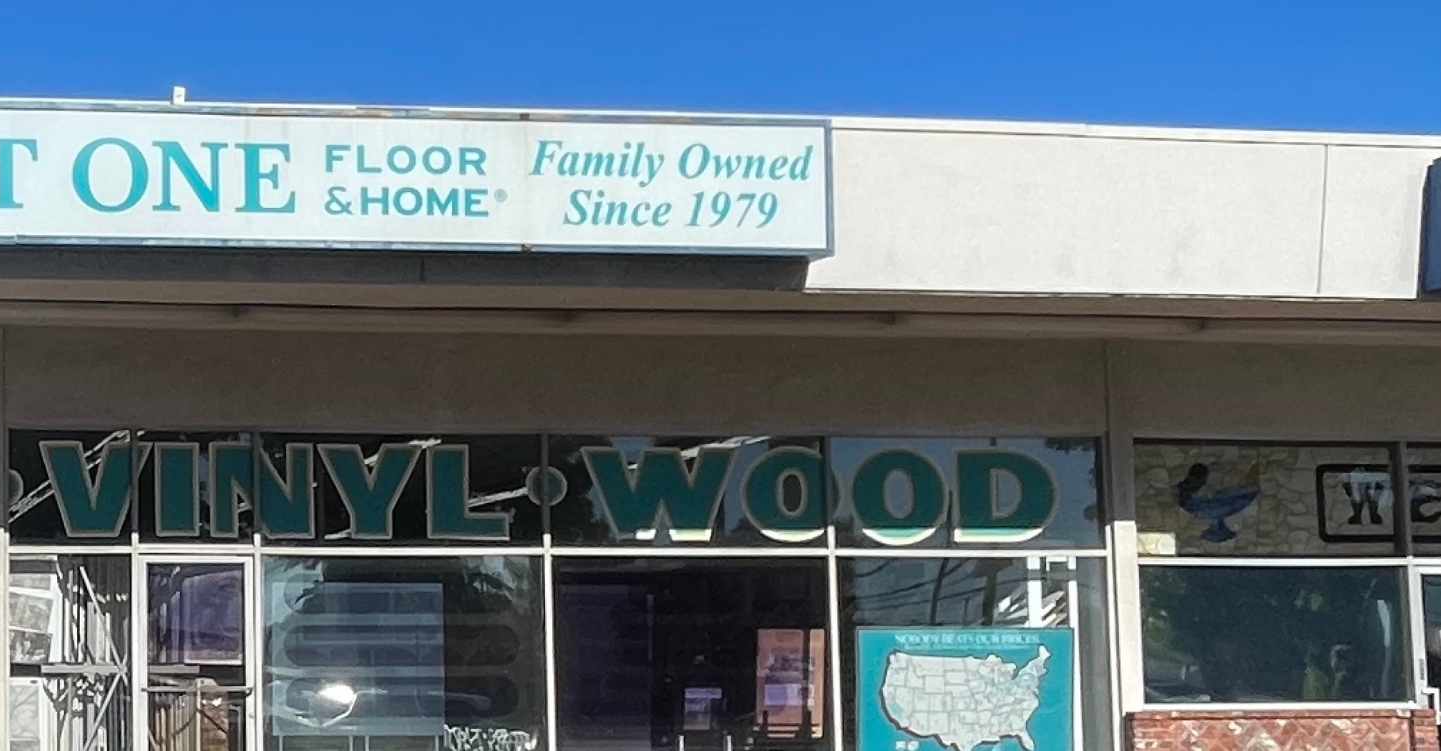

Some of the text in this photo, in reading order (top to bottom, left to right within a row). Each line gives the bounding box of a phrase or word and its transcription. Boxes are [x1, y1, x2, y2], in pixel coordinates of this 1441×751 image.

[71, 135, 296, 215] ONE
[324, 144, 488, 177] FLOOR
[529, 139, 815, 188] Family Owned
[562, 188, 779, 229] Since 1979
[38, 439, 510, 542] VINYL
[580, 445, 1057, 546] WOOD
